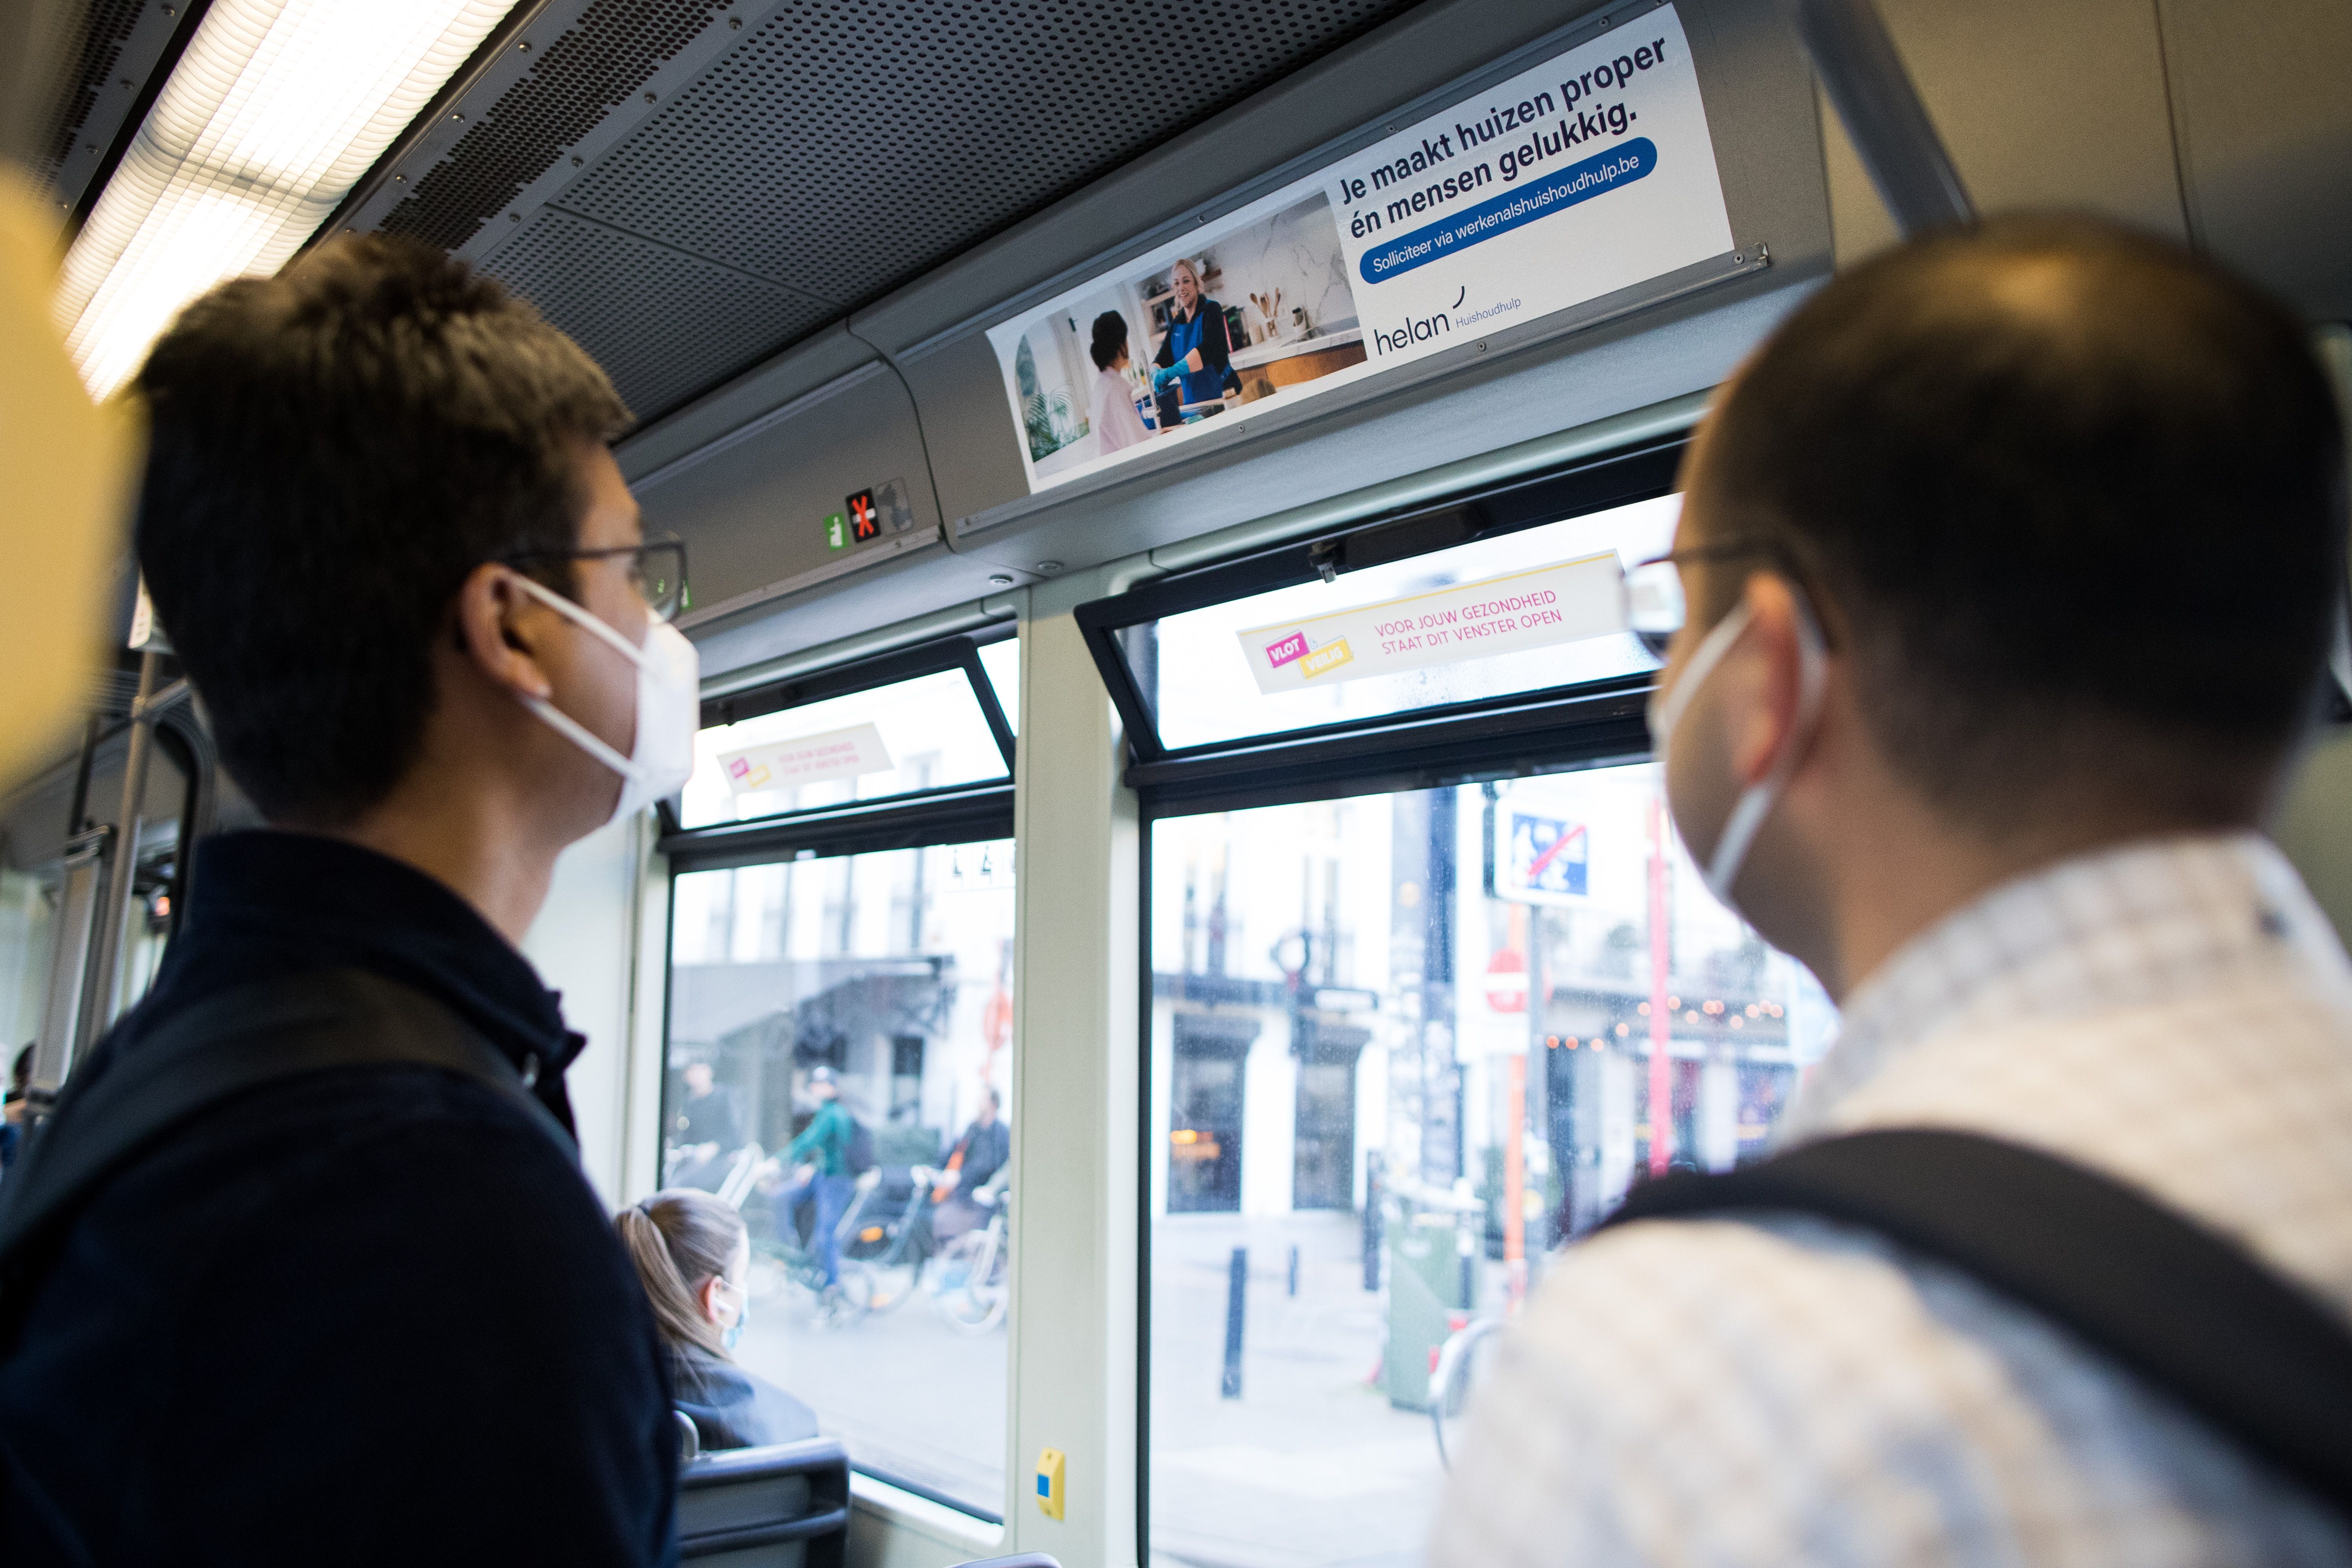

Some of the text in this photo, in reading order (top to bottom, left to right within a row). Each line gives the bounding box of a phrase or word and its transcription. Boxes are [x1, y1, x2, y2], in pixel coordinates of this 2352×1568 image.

[1339, 37, 1666, 205] Je maakt huizen proper
[1350, 102, 1637, 239] én mensen gelukkig.
[1373, 156, 1639, 272] Solliciteer via werkenalshuishoudhulp.be
[1374, 298, 1521, 356] helan Huishoudhulp
[1375, 590, 1556, 637] VOOR JOUW GEZONDHEID
[1382, 609, 1563, 654] STAAT DIT VENSTER OPEN
[1270, 638, 1299, 661] VLOT
